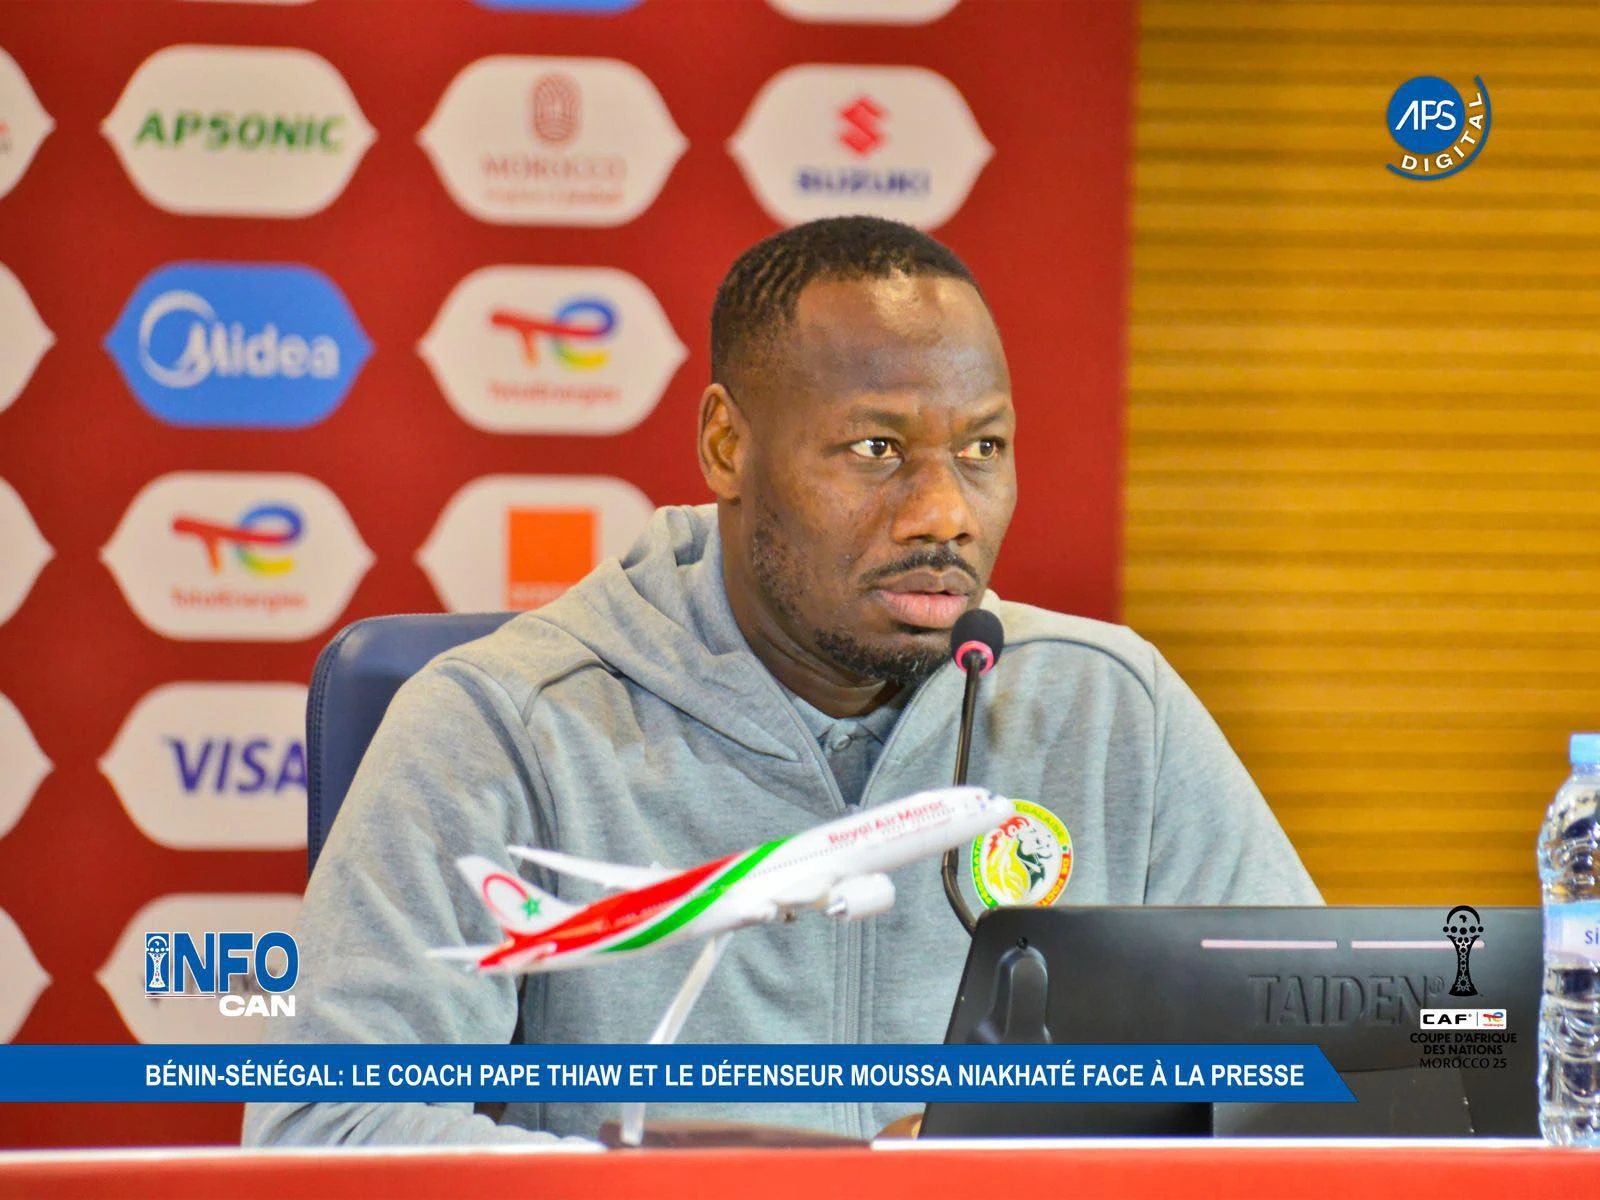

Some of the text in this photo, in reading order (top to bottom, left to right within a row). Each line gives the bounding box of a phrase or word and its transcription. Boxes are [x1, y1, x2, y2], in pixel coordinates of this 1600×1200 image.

[135, 109, 344, 155] APSONIC
[796, 168, 931, 195] SUZUKI
[139, 290, 340, 388] Midea
[167, 740, 308, 793] VISA
[828, 823, 871, 844] Royal
